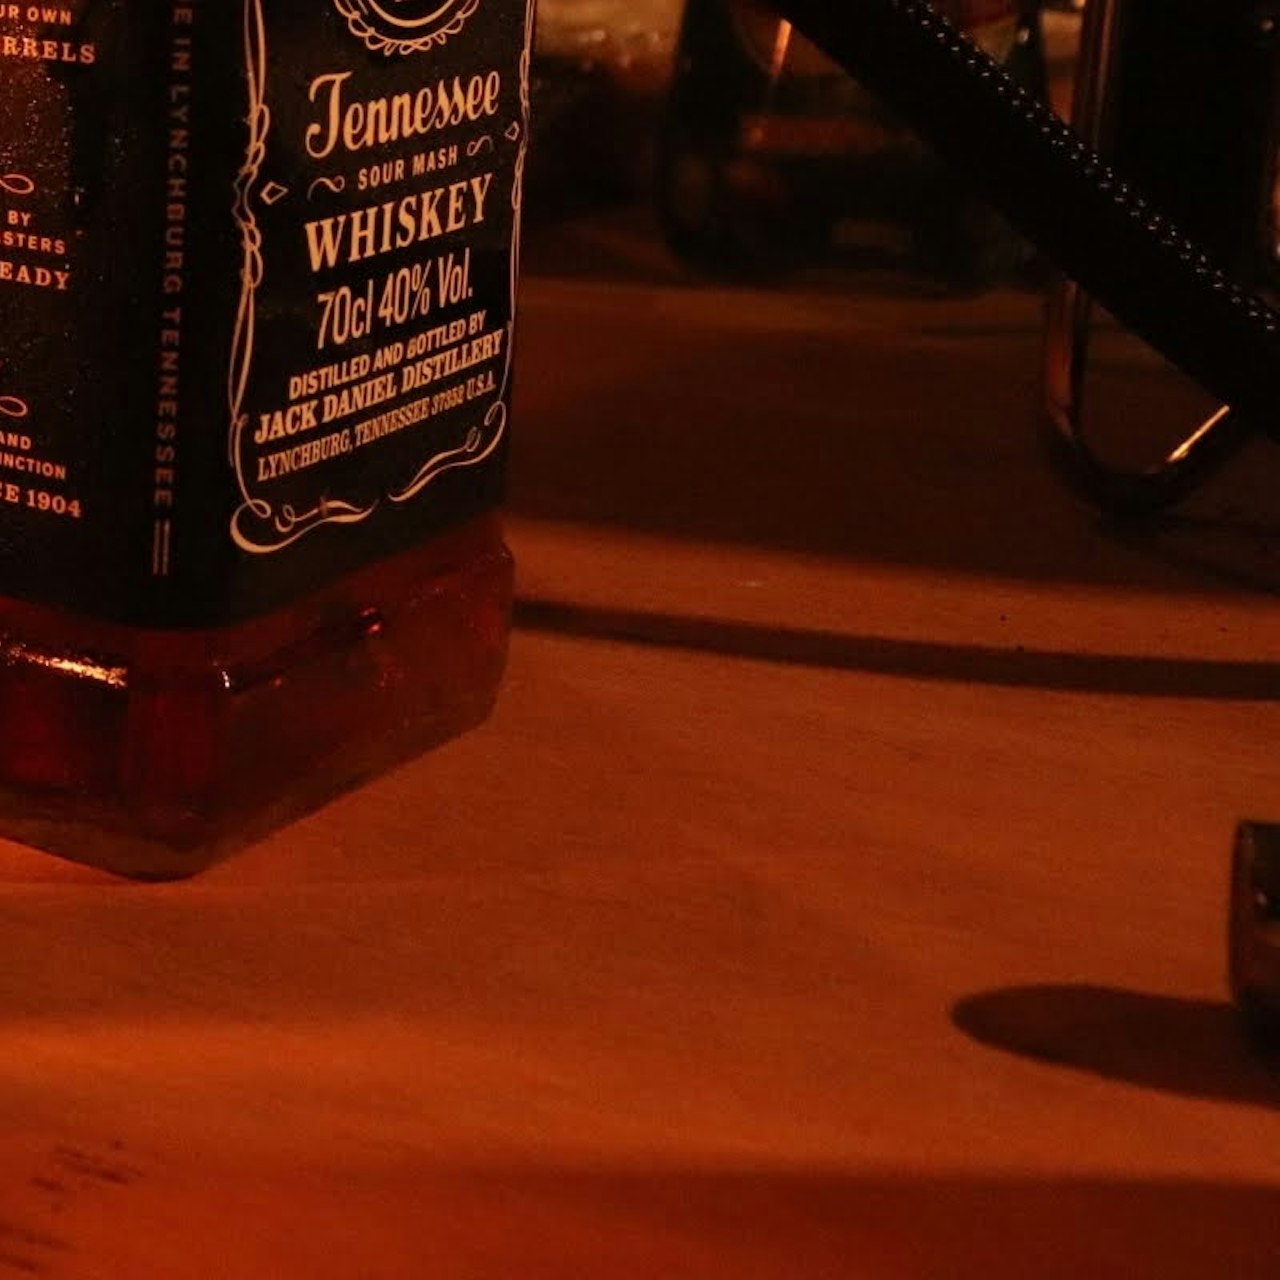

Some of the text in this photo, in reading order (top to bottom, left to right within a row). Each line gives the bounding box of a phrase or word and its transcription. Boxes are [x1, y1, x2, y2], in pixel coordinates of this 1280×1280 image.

[27, 7, 72, 26] OWN
[172, 37, 191, 70] IN
[305, 70, 500, 159] Tennessee
[162, 84, 190, 295] LYNCHBURG
[357, 145, 458, 190] SOUR MASH
[8, 209, 32, 228] BY
[304, 173, 492, 272] WHISKEY
[317, 247, 473, 350] 70cl 40% Vol.
[254, 328, 504, 445] JACK DANIEL DISTILLERY
[290, 310, 487, 400] DISTILLED AND BOTTLED BY
[154, 309, 181, 507] TENNESSEE
[257, 429, 353, 483] LYNCHBURG,
[354, 397, 430, 448] TENNESSEE
[26, 489, 83, 519] 1904
